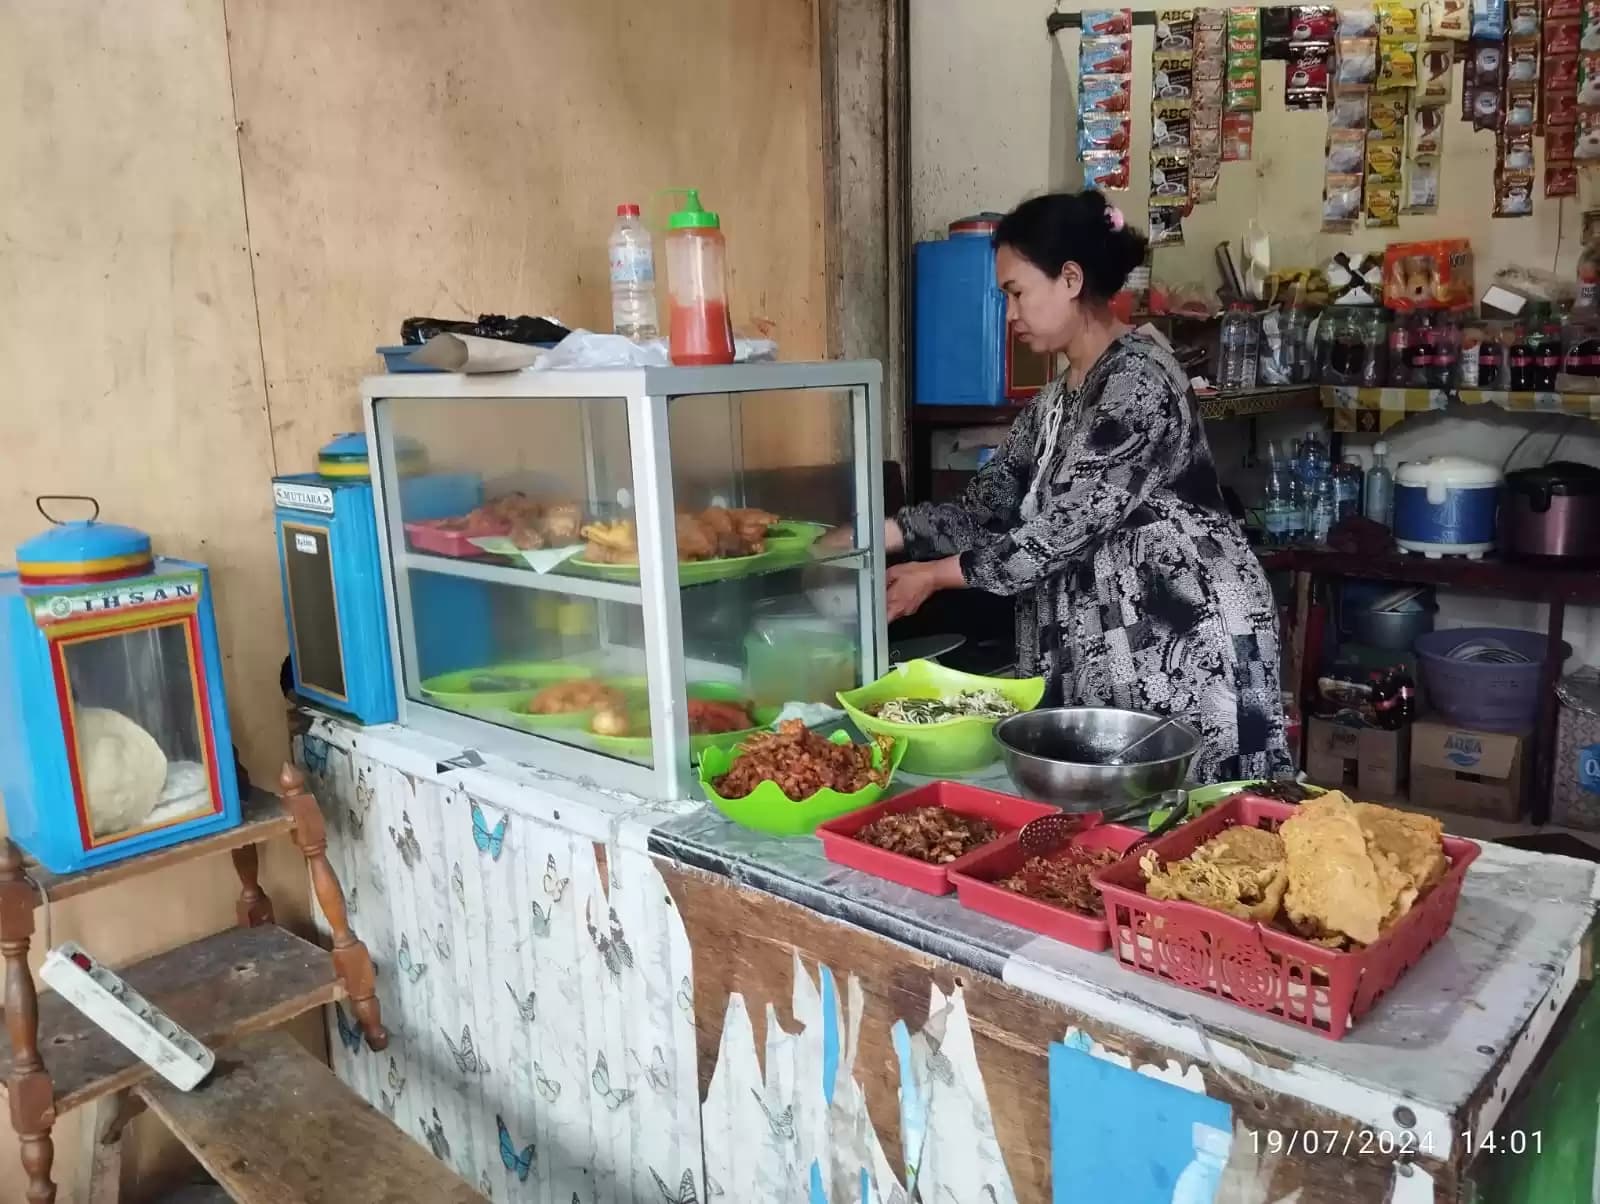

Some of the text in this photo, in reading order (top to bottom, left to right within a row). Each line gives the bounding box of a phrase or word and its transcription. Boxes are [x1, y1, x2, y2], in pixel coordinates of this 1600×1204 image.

[1160, 10, 1191, 21] ABC
[1159, 58, 1190, 71] ABC
[1158, 107, 1190, 120] ABC
[1156, 156, 1187, 168] ABC
[283, 491, 323, 504] MUTIARA
[84, 583, 193, 612] IHSAN
